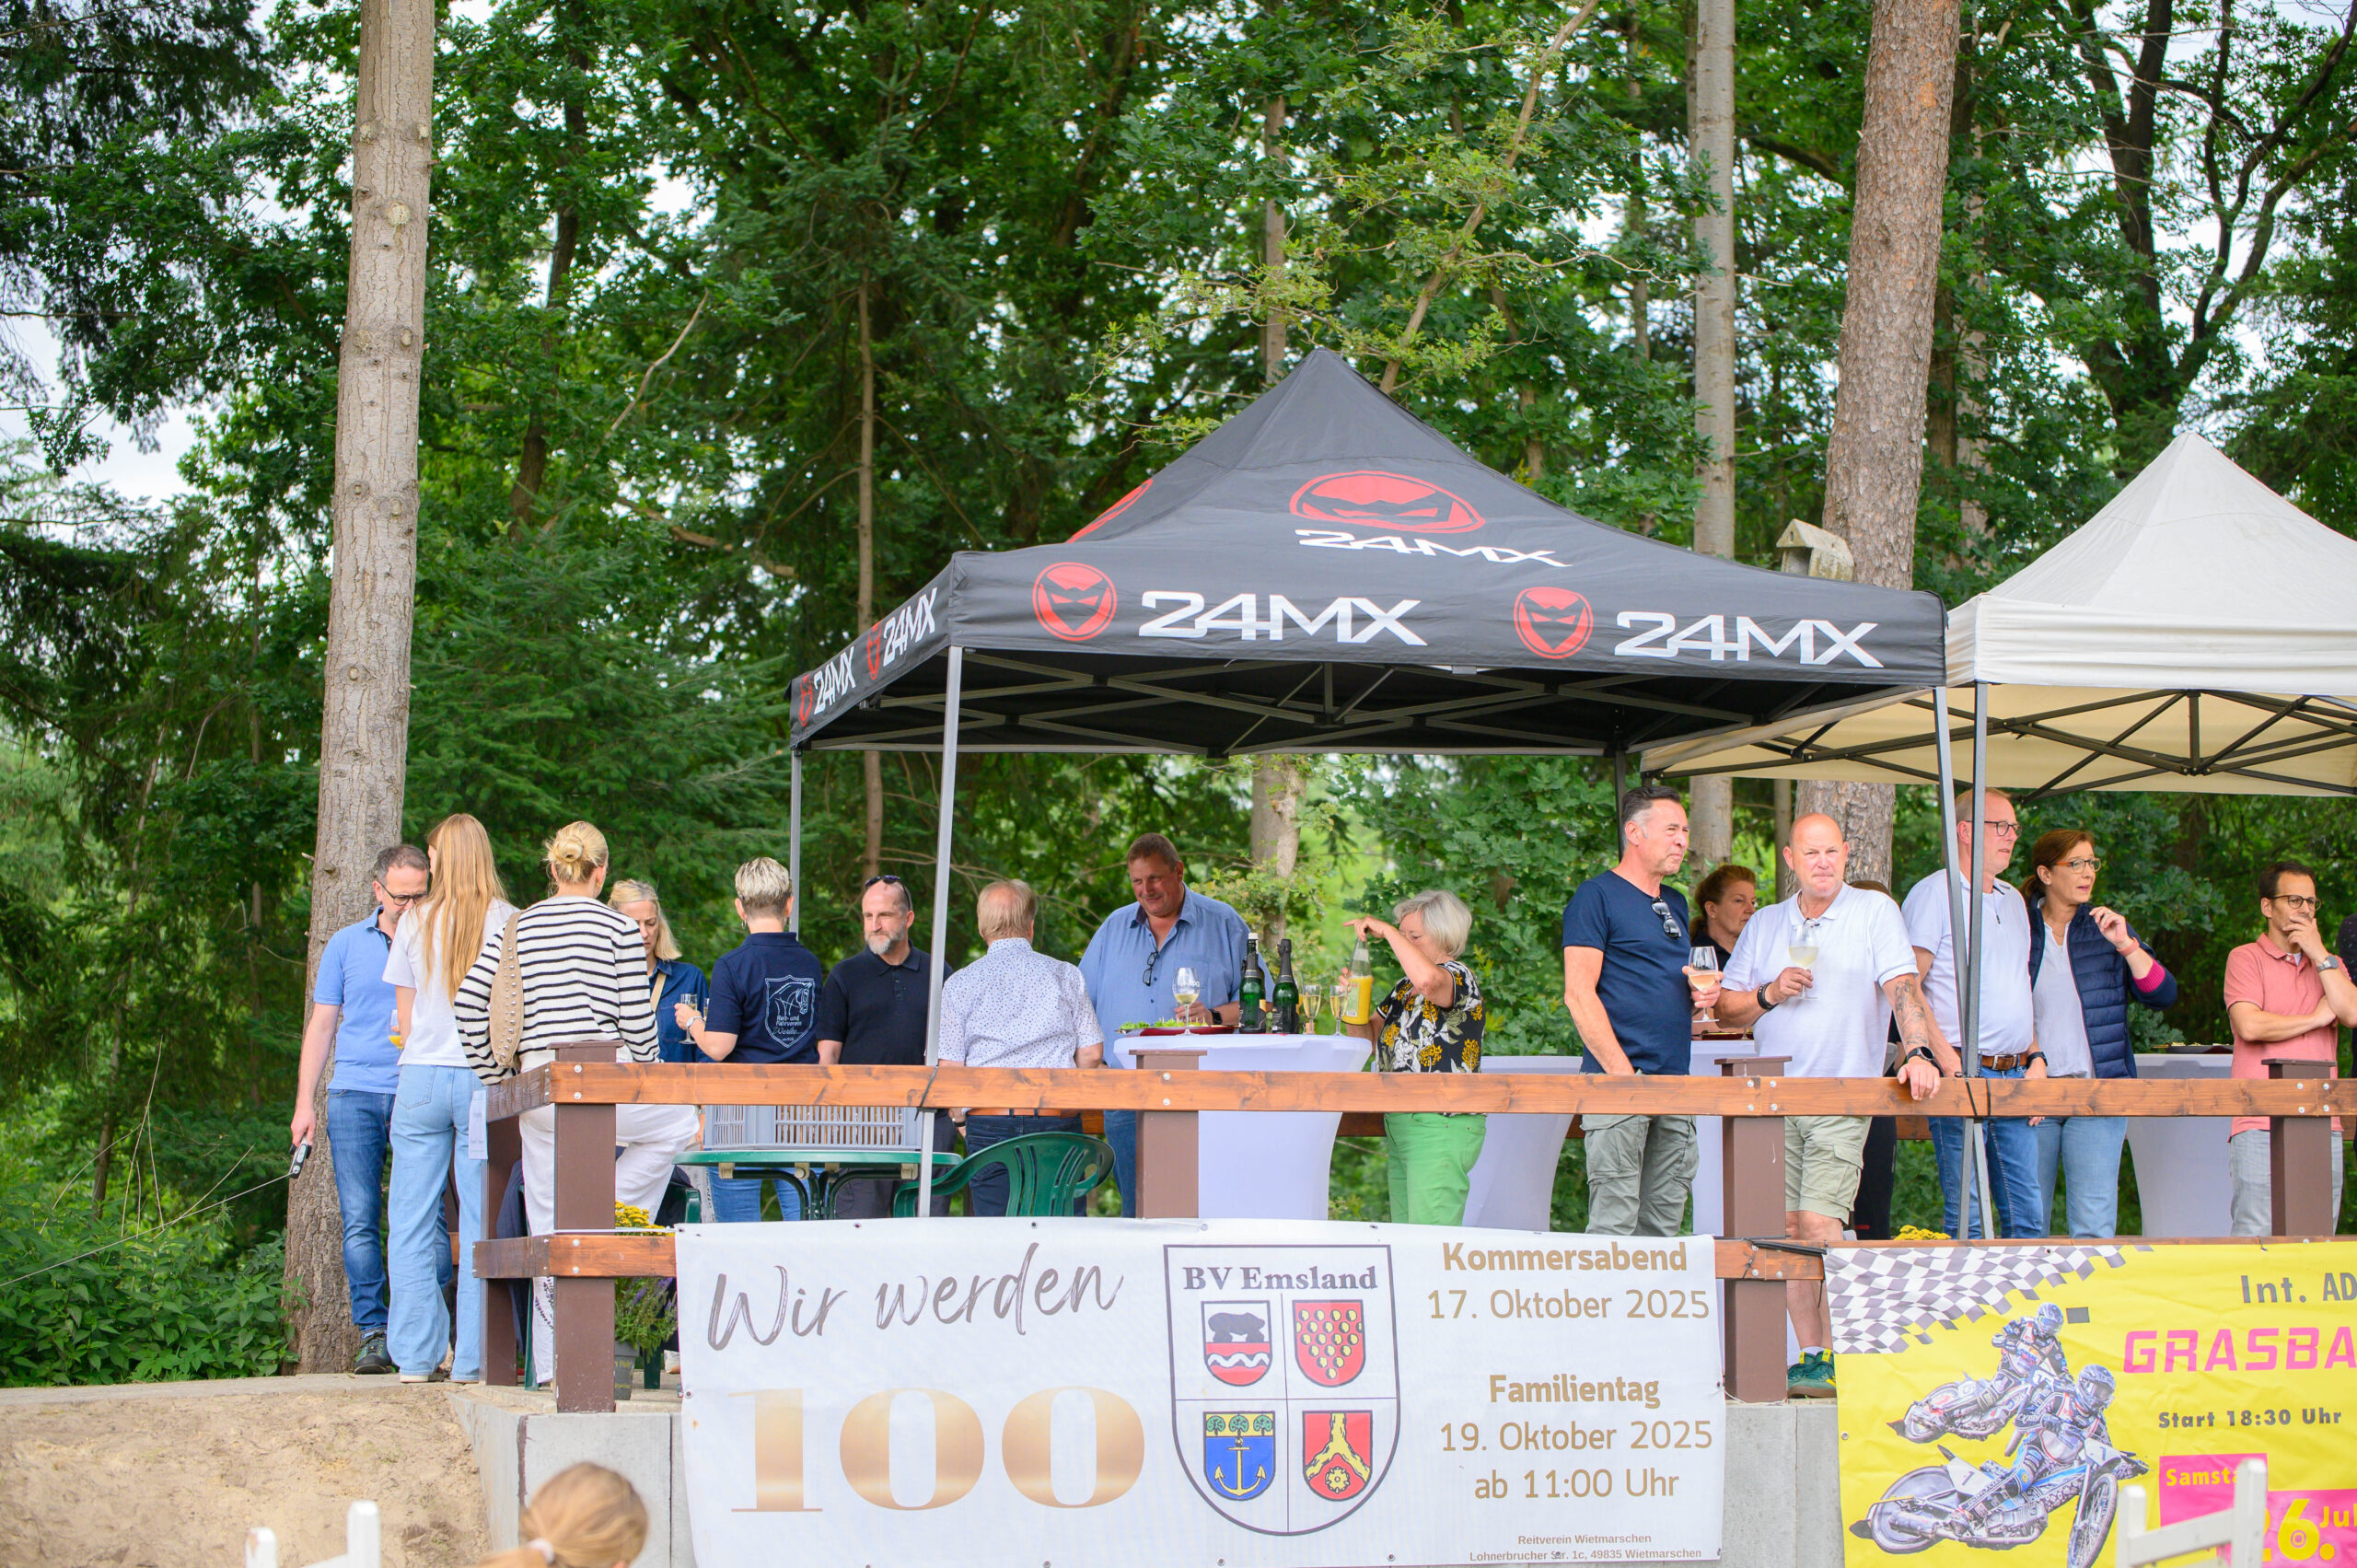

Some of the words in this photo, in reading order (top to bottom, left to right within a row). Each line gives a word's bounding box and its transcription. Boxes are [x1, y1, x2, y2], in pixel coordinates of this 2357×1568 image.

[1295, 528, 1573, 568] 24MX
[882, 587, 937, 667] 24MX
[1139, 590, 1428, 646] 24MX
[1614, 610, 1884, 668] 24MX
[813, 645, 856, 715] 24MX
[1443, 1241, 1687, 1272] Kommersabend
[1182, 1266, 1233, 1290] BV
[1239, 1265, 1378, 1290] Emsland
[2241, 1275, 2306, 1304] Int.
[708, 1265, 848, 1351] Wir
[876, 1242, 1124, 1336] werden
[1428, 1290, 1477, 1318] 17.
[1490, 1288, 1611, 1318] Oktober
[1625, 1289, 1709, 1318] 2025
[2123, 1327, 2357, 1373] GRASBA
[1489, 1373, 1661, 1410] Familientag
[2159, 1412, 2215, 1428] Start
[2227, 1409, 2291, 1426] 18:30
[2303, 1407, 2341, 1424] Uhr
[727, 1386, 1145, 1513] 100
[1440, 1422, 1487, 1451] 19.
[1499, 1421, 1617, 1450] Oktober
[1630, 1421, 1712, 1449] 2025
[1474, 1469, 1508, 1499] ab
[1524, 1469, 1612, 1499] 11:00
[1625, 1467, 1679, 1497] Uhr
[2166, 1467, 2236, 1486] Samst
[1517, 1535, 1572, 1545] Reitverein
[1574, 1534, 1652, 1544] Wietmarschen
[2262, 1498, 2336, 1562] 6.
[1469, 1551, 1547, 1562] Lohnerbrucher
[1550, 1551, 1569, 1561] Sr.
[1572, 1551, 1587, 1562] 1c,
[1590, 1550, 1622, 1560] 49835
[1625, 1549, 1701, 1559] Wietmarschen
